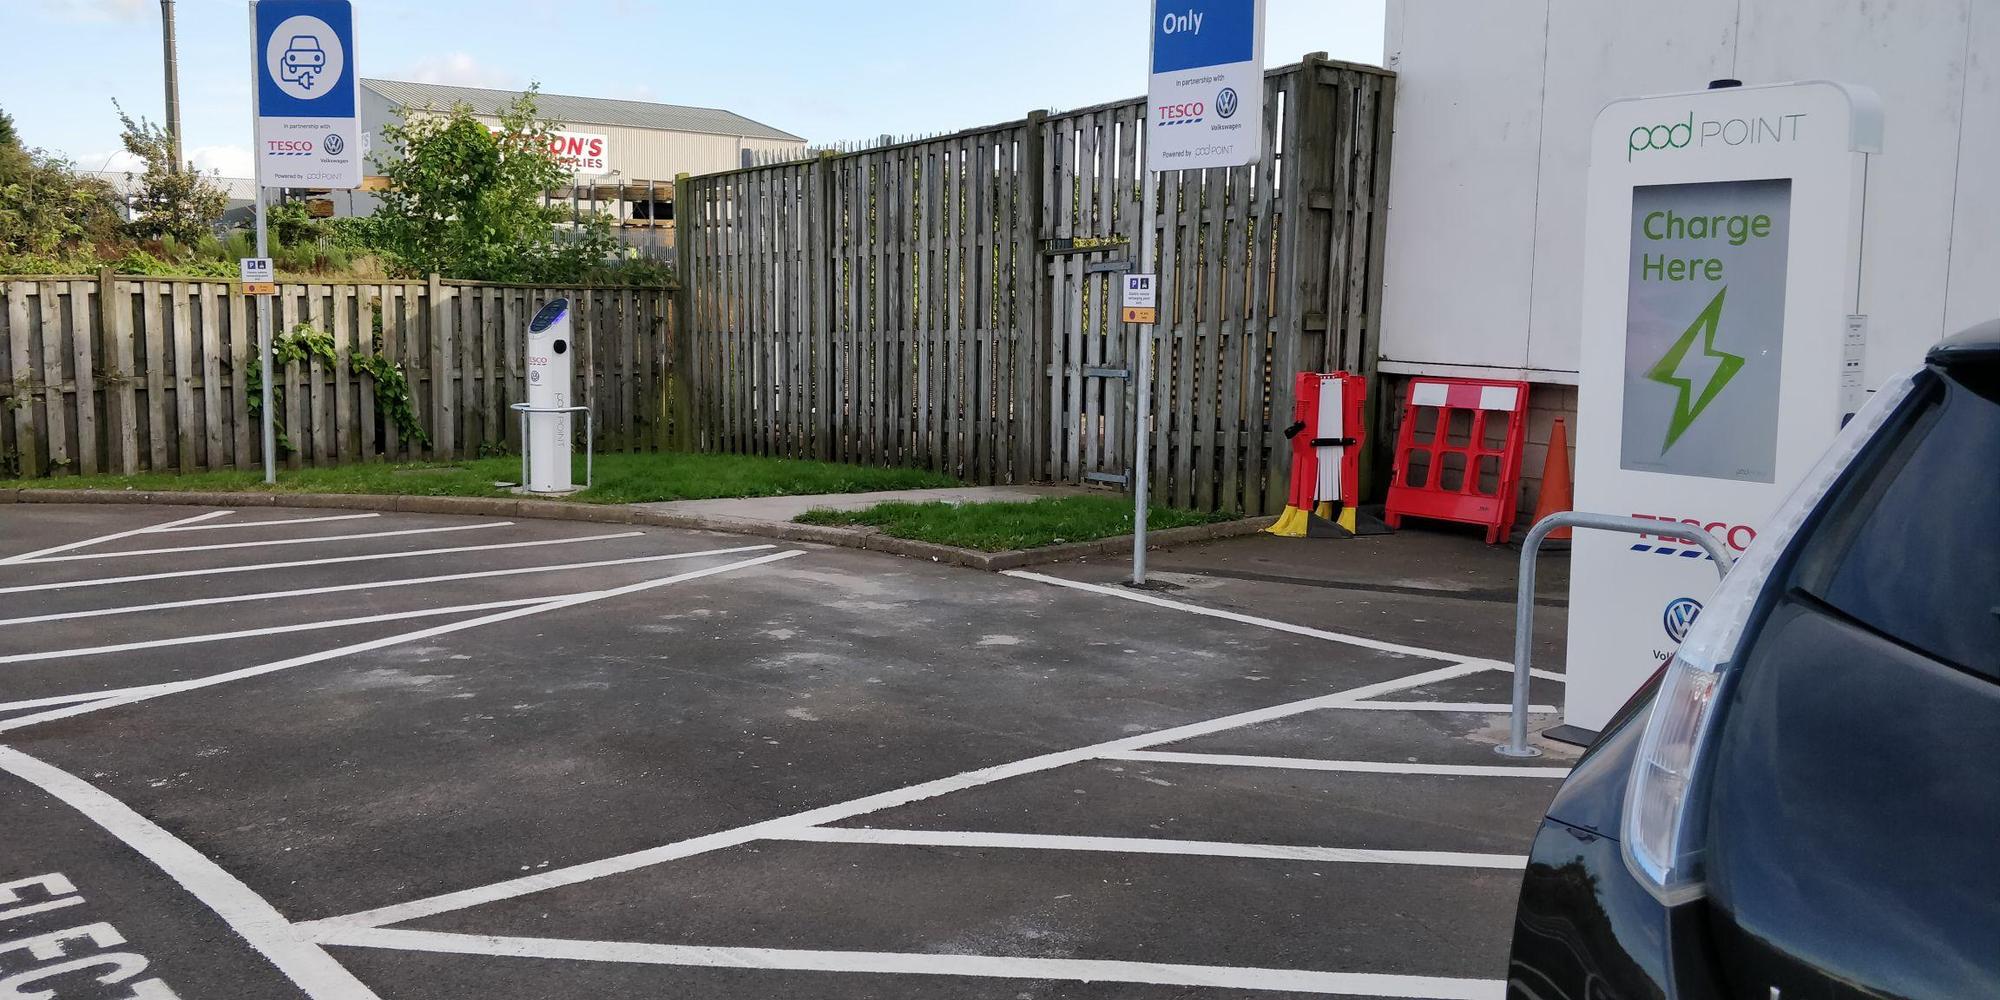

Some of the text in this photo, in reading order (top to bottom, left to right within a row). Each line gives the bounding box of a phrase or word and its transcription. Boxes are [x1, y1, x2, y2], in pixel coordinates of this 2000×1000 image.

[1163, 9, 1204, 35] Only
[1182, 77, 1212, 87] partnership
[1213, 75, 1225, 83] with
[1159, 102, 1204, 119] TESCO
[1211, 123, 1241, 131] Volkswagen
[1629, 110, 1807, 163] pod POINT
[268, 141, 313, 151] TESCO
[1162, 150, 1184, 158] Powered
[1185, 150, 1192, 158] by
[1643, 210, 1772, 246] Charge
[1642, 253, 1723, 282] Here
[0, 872, 182, 1000] ELEC
